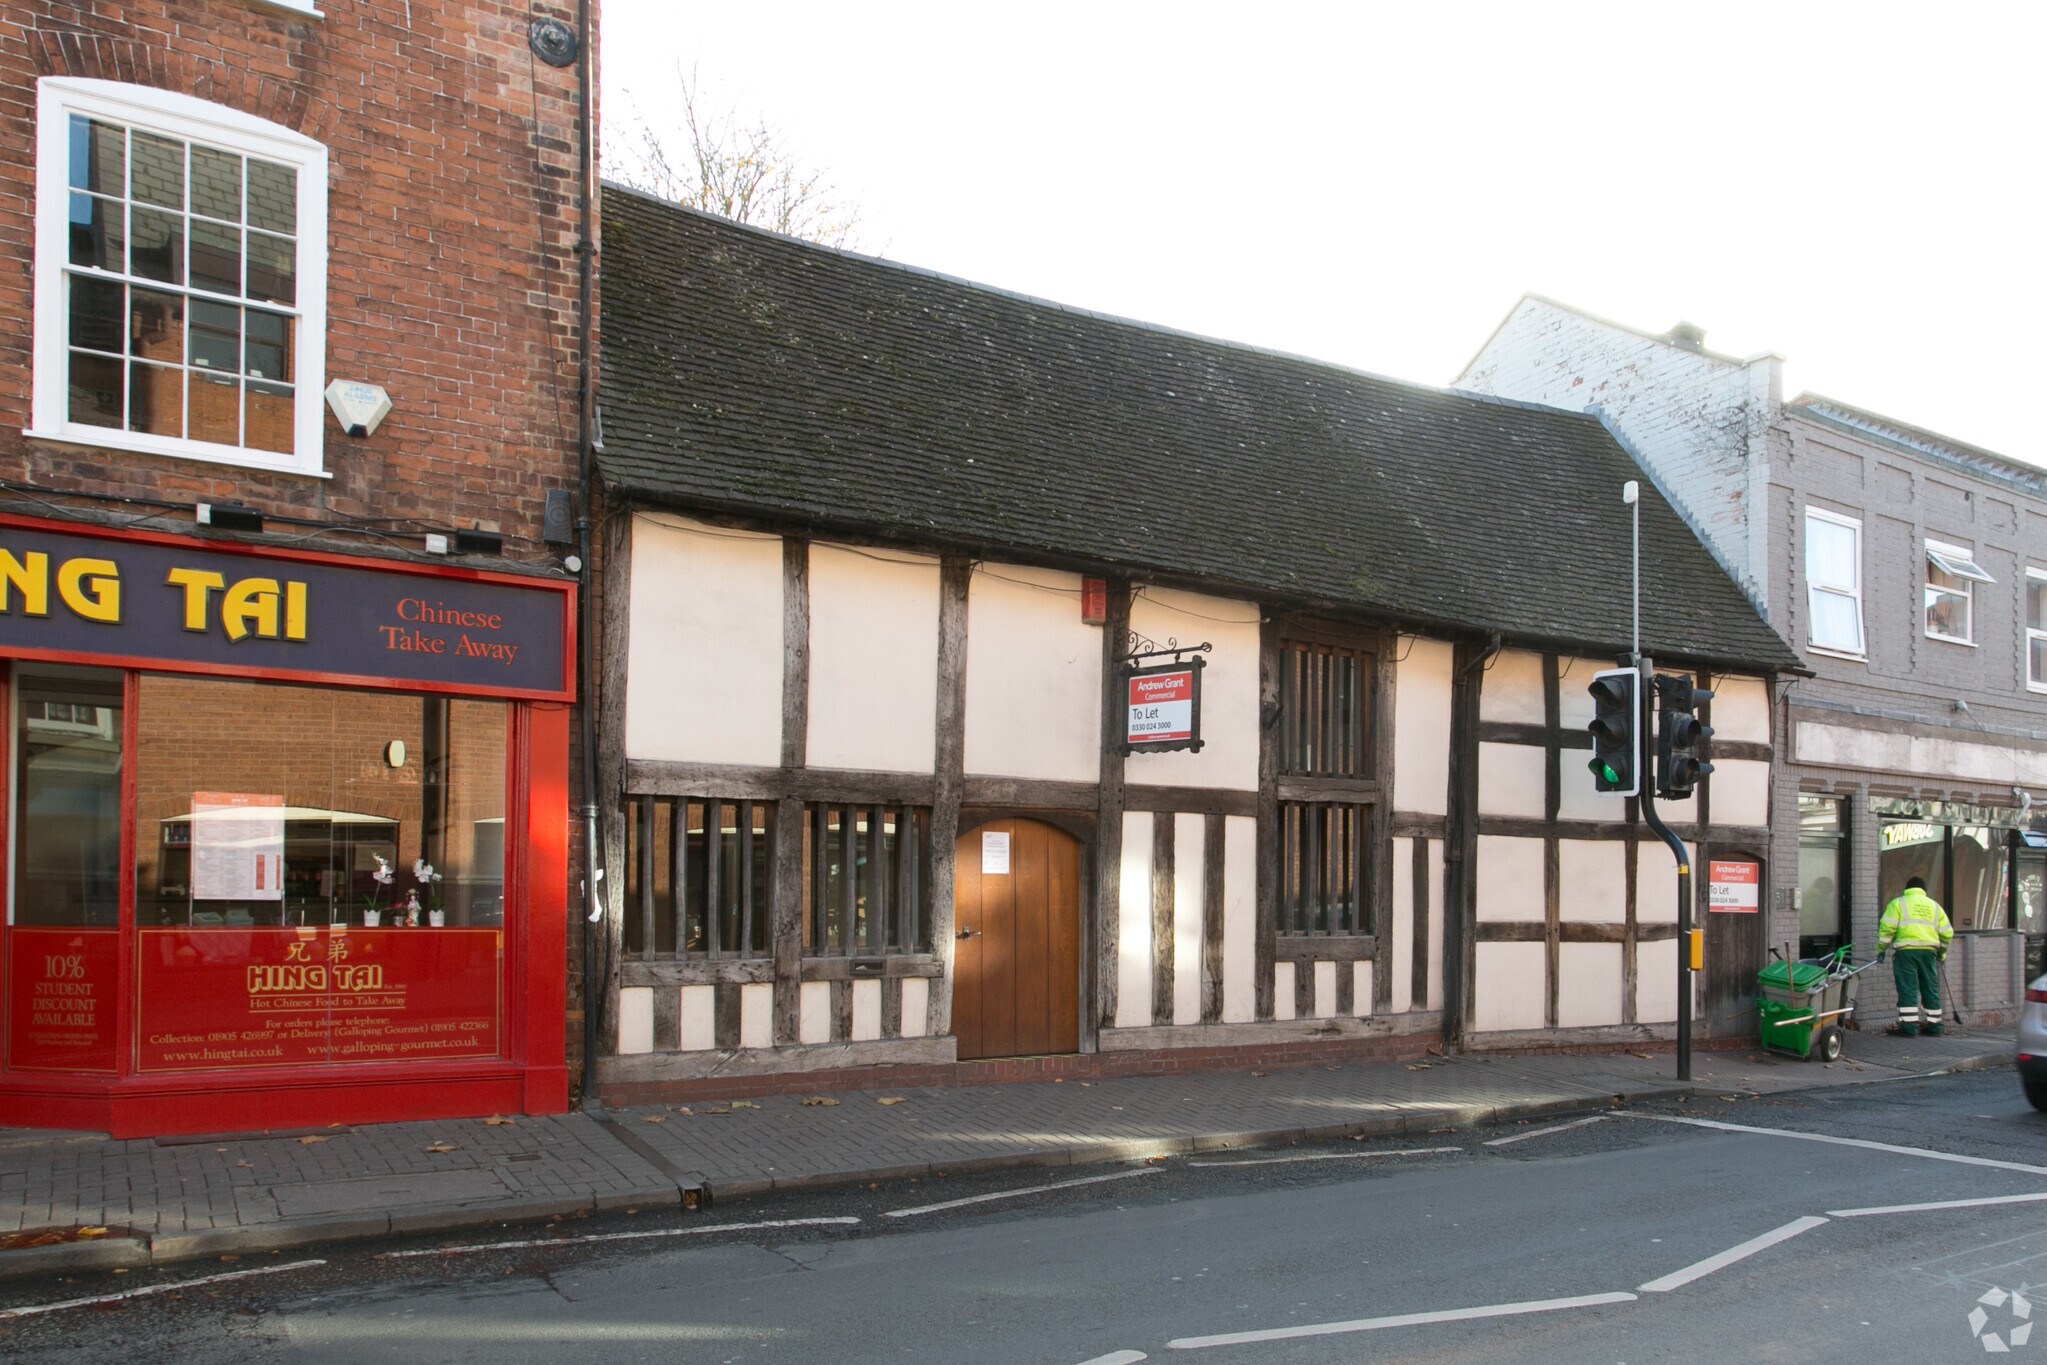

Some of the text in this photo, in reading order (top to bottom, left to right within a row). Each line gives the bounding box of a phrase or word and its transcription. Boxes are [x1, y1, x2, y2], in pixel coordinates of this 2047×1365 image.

[166, 567, 307, 641] TAI
[396, 597, 502, 630] Chinese
[379, 625, 518, 666] Take Away
[1137, 677, 1184, 691] Andrew Grant
[1144, 690, 1176, 700] Commercial
[1132, 707, 1159, 720] To Let
[1131, 721, 1171, 731] 0330 024 3000
[1715, 865, 1736, 873] Andrew
[1709, 885, 1729, 895] To Let
[44, 955, 85, 978] 10%
[247, 965, 327, 993] HING
[333, 965, 382, 991] TAI
[35, 982, 93, 995] STUDENT
[32, 998, 96, 1011] DISCOUNT
[250, 995, 406, 1008] Hot Chinese Food to Take Away
[31, 1013, 95, 1026] AVAILABLE
[265, 1016, 390, 1029] For orders please telephone:
[150, 1034, 205, 1044] Collection:
[207, 1032, 237, 1042] 01905
[240, 1030, 275, 1040] 426997
[277, 1031, 289, 1039] or
[334, 1026, 382, 1037] (Galloping
[384, 1024, 428, 1034] Gourmet)
[430, 1022, 456, 1032] 01905
[458, 1021, 489, 1031] 422366
[163, 1036, 479, 1061] www.hingtai.co.uk www.galloping-gourmet.co.uk
